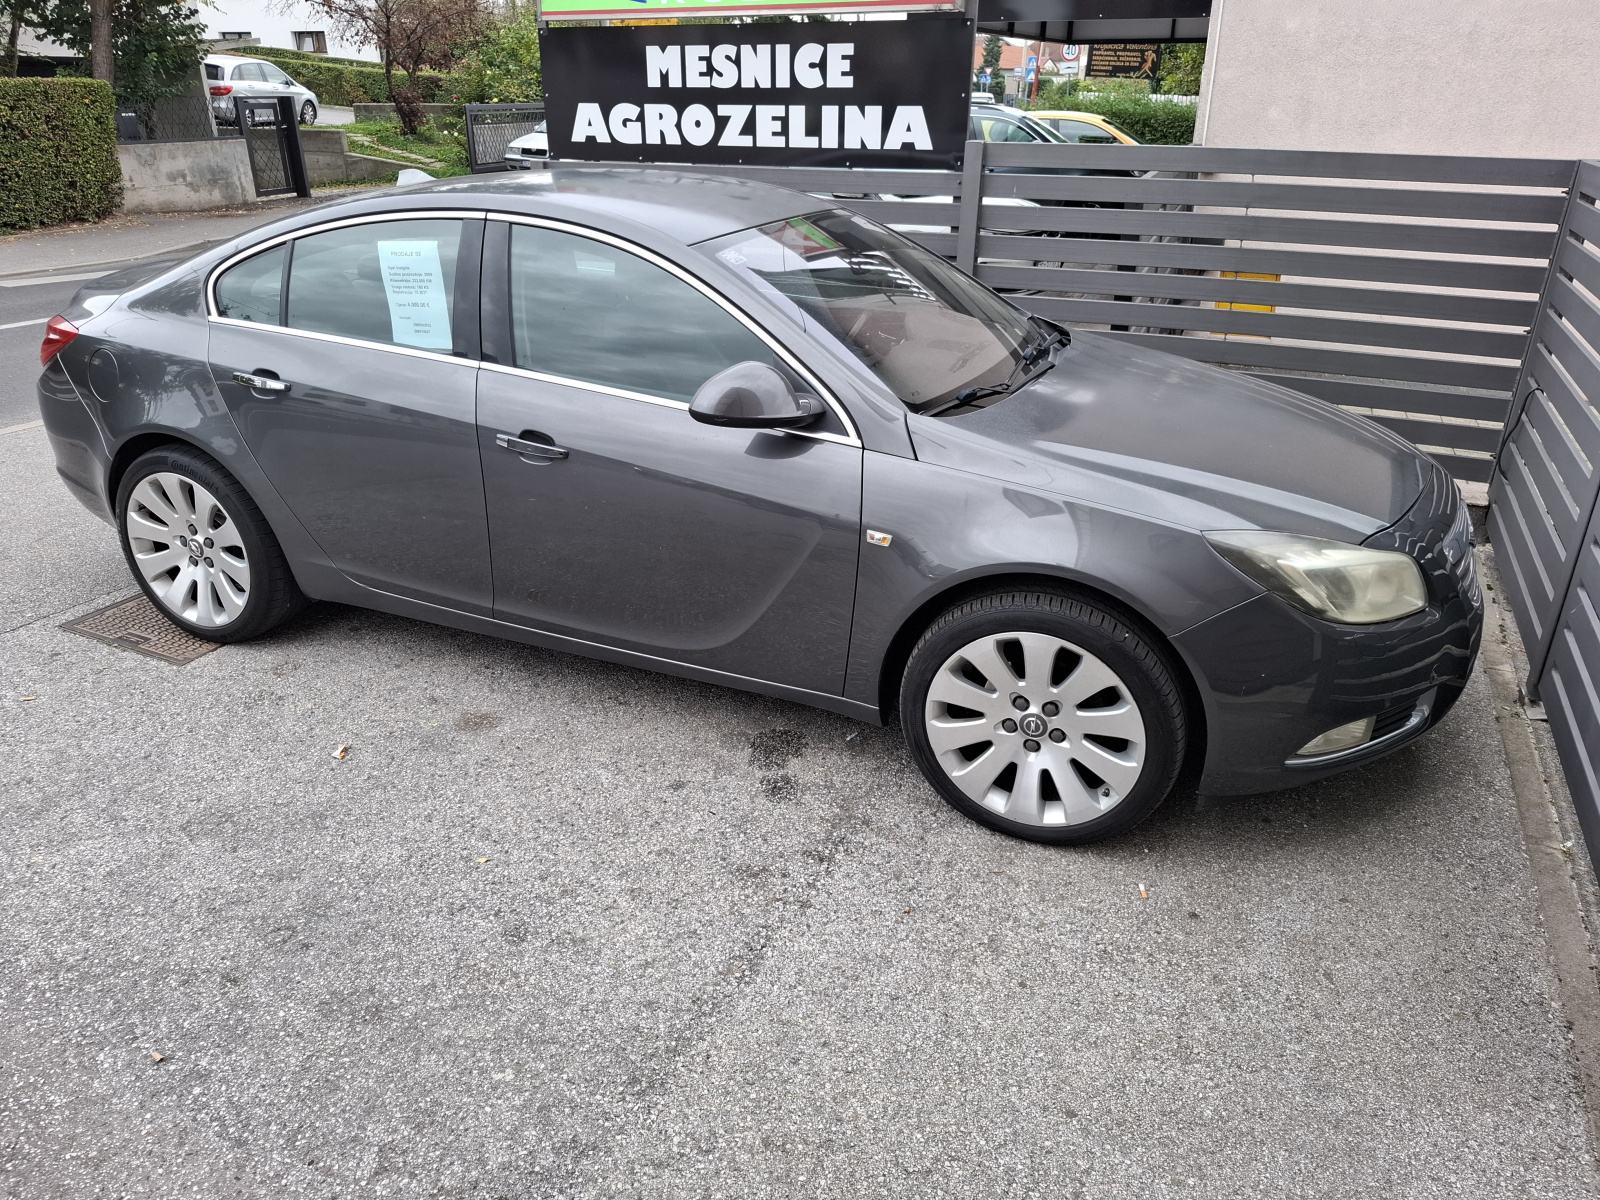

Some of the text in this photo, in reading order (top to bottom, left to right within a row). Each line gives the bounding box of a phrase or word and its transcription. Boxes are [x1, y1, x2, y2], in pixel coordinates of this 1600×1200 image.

[645, 42, 855, 89] MESNICE
[1065, 44, 1077, 56] 40
[571, 102, 934, 151] AGROZELINA
